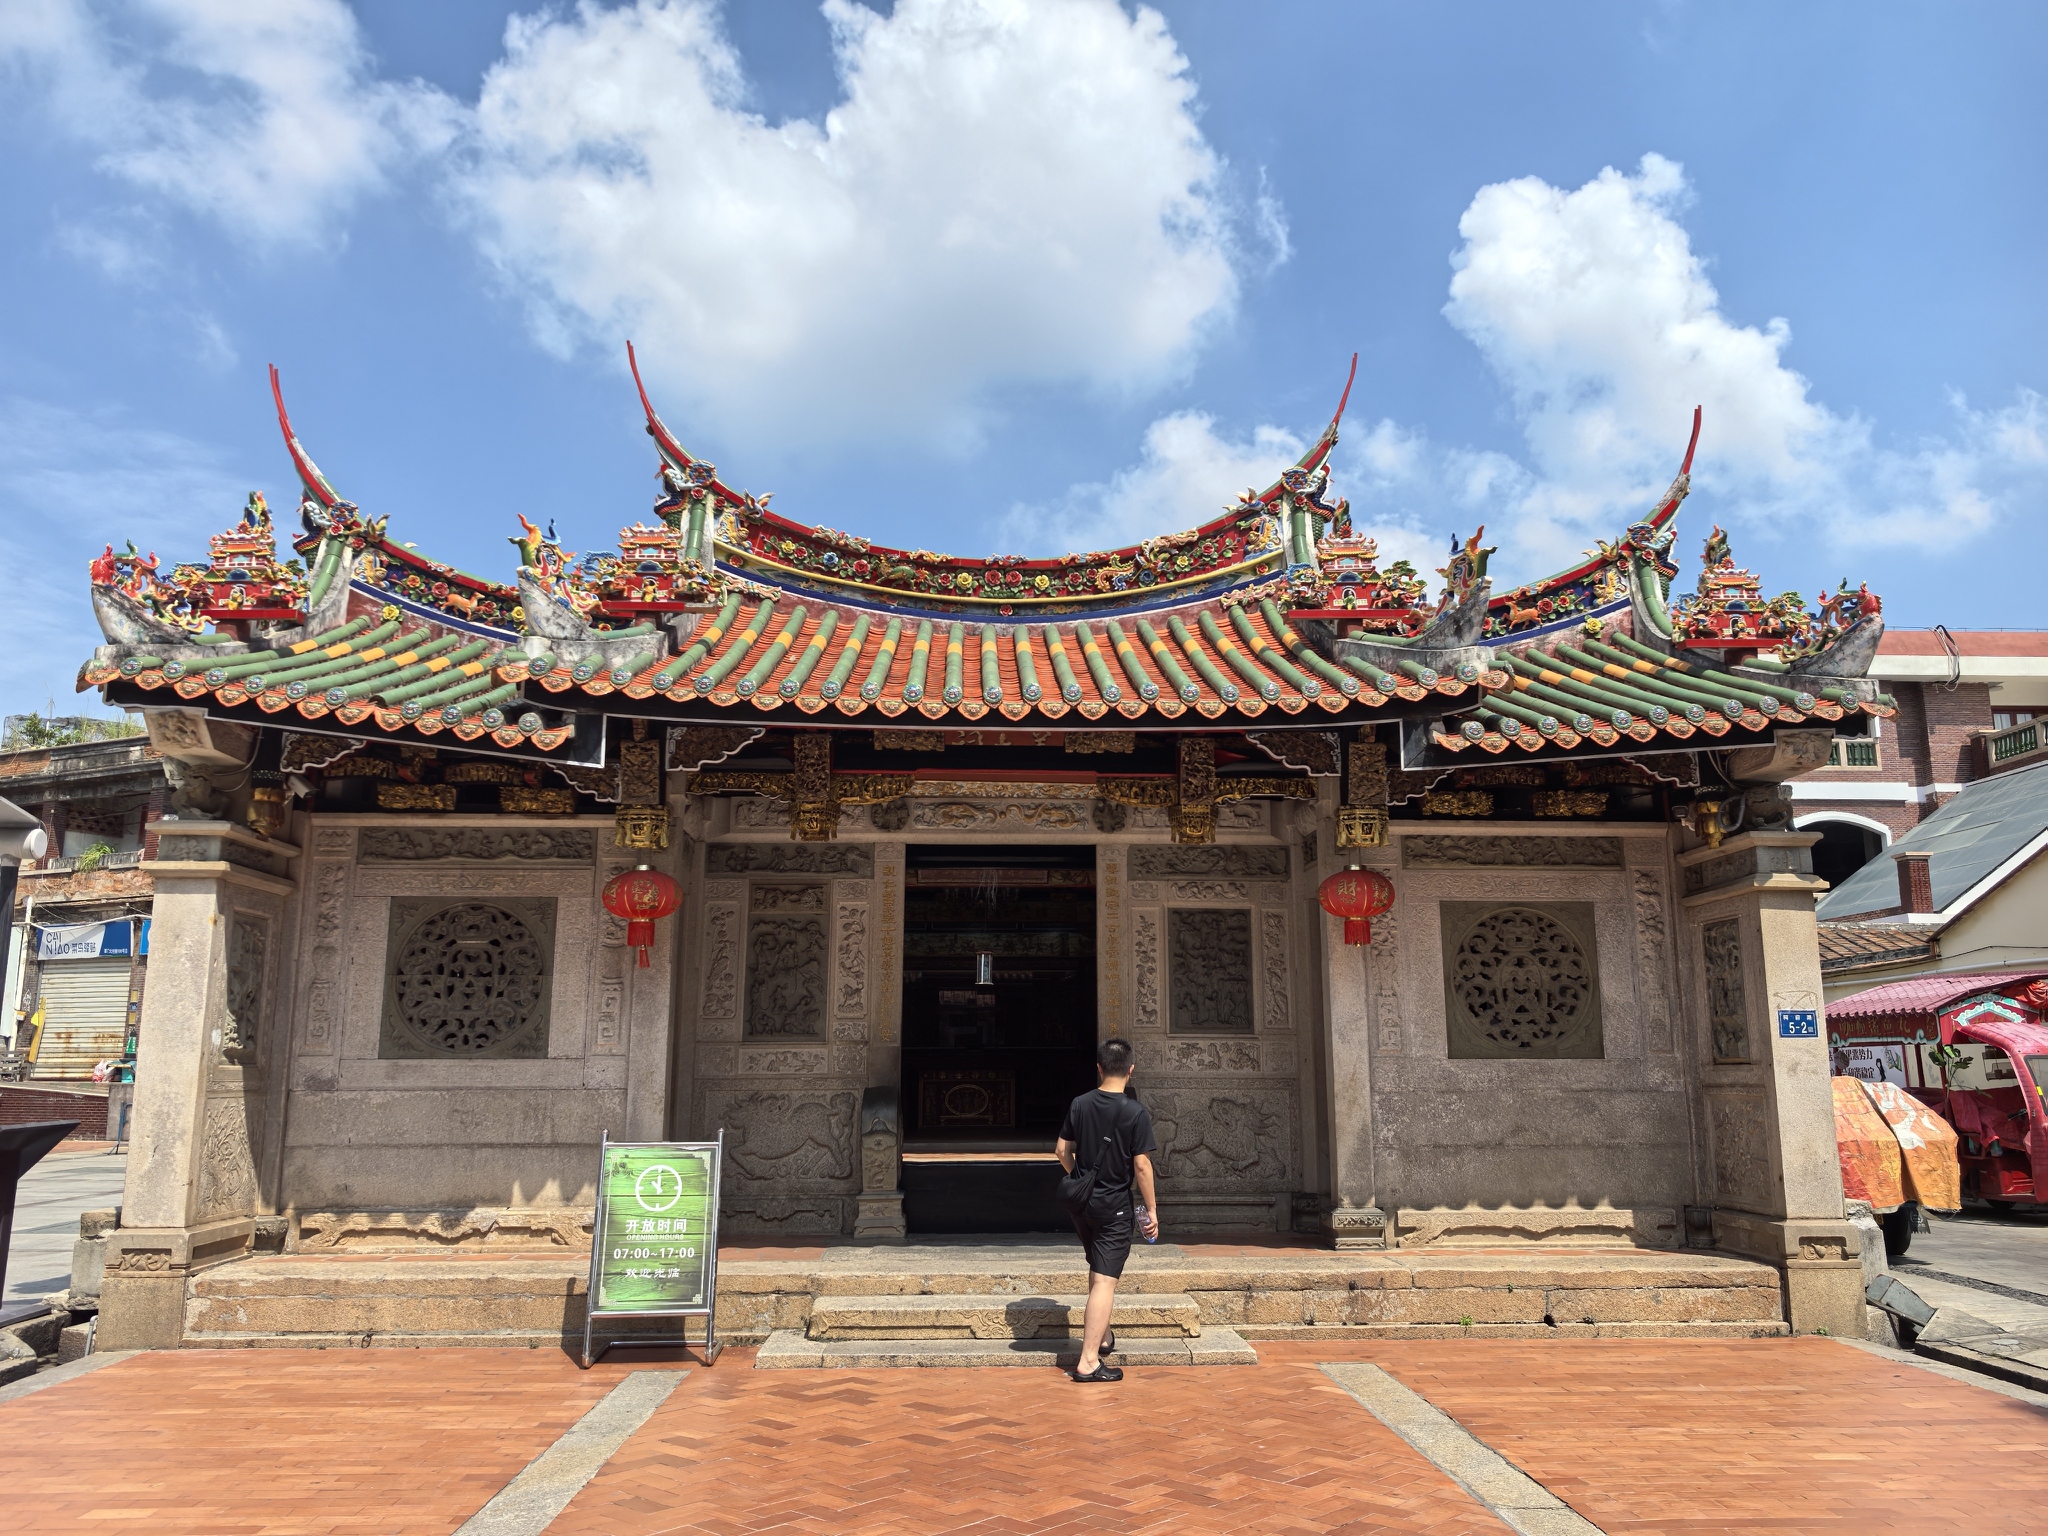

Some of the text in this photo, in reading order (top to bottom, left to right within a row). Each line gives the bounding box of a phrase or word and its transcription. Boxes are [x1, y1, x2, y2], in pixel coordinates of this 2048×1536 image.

[625, 1218, 687, 1233] 开放时间
[613, 1247, 695, 1259] 07:00~17:00
[625, 1268, 681, 1278] 欢迎光临
